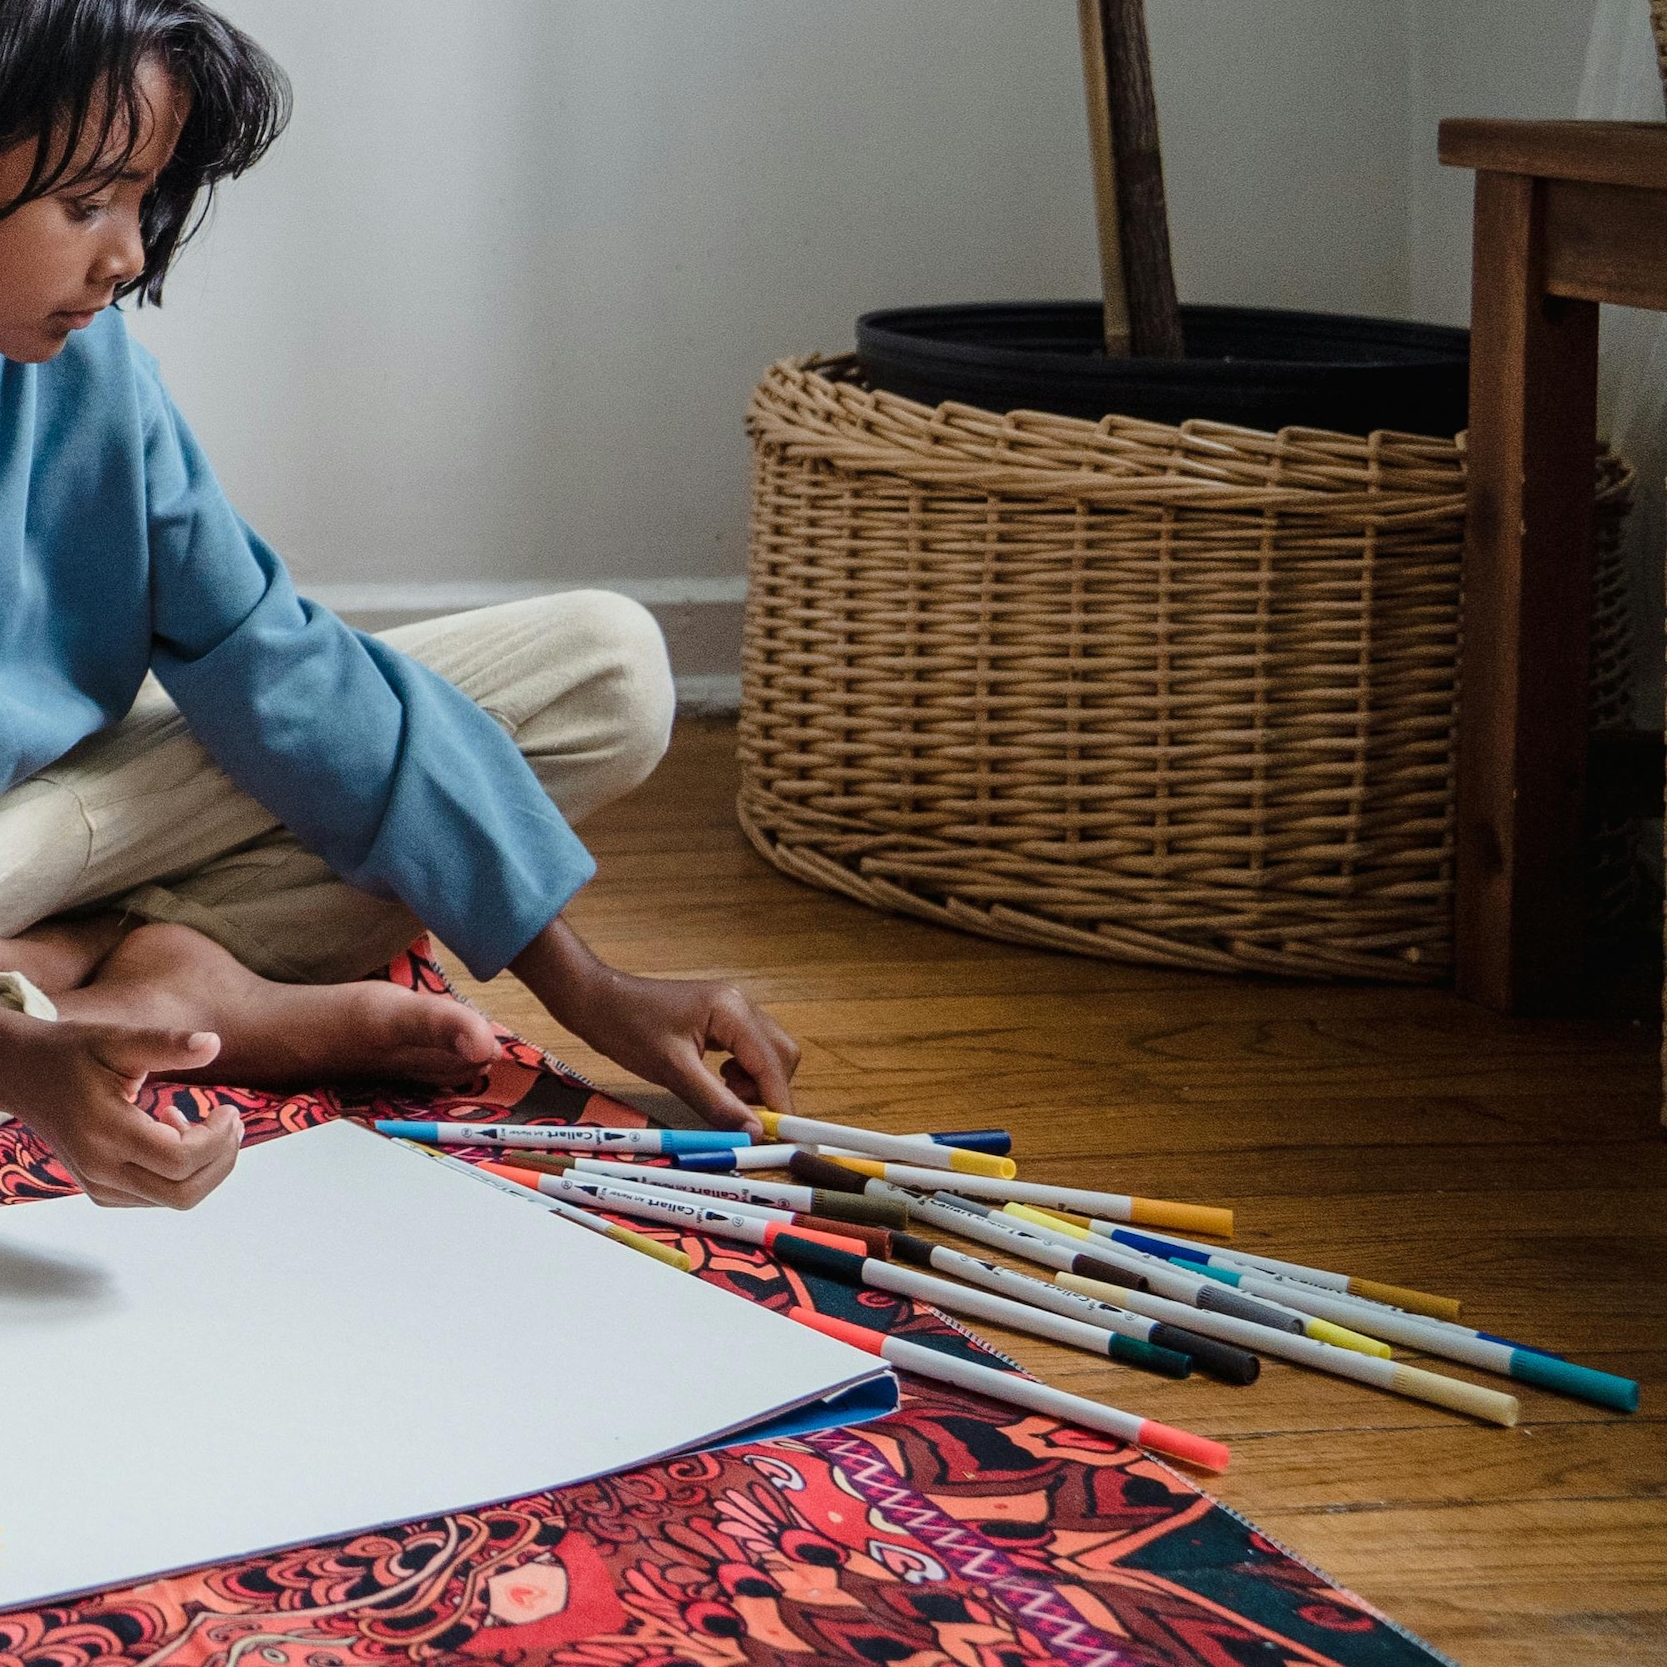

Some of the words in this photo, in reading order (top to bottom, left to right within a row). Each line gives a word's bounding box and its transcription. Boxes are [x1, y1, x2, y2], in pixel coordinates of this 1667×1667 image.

[548, 1130, 592, 1140] Caliart
[688, 1186, 739, 1200] Caliart
[647, 1199, 694, 1215] Caliart
